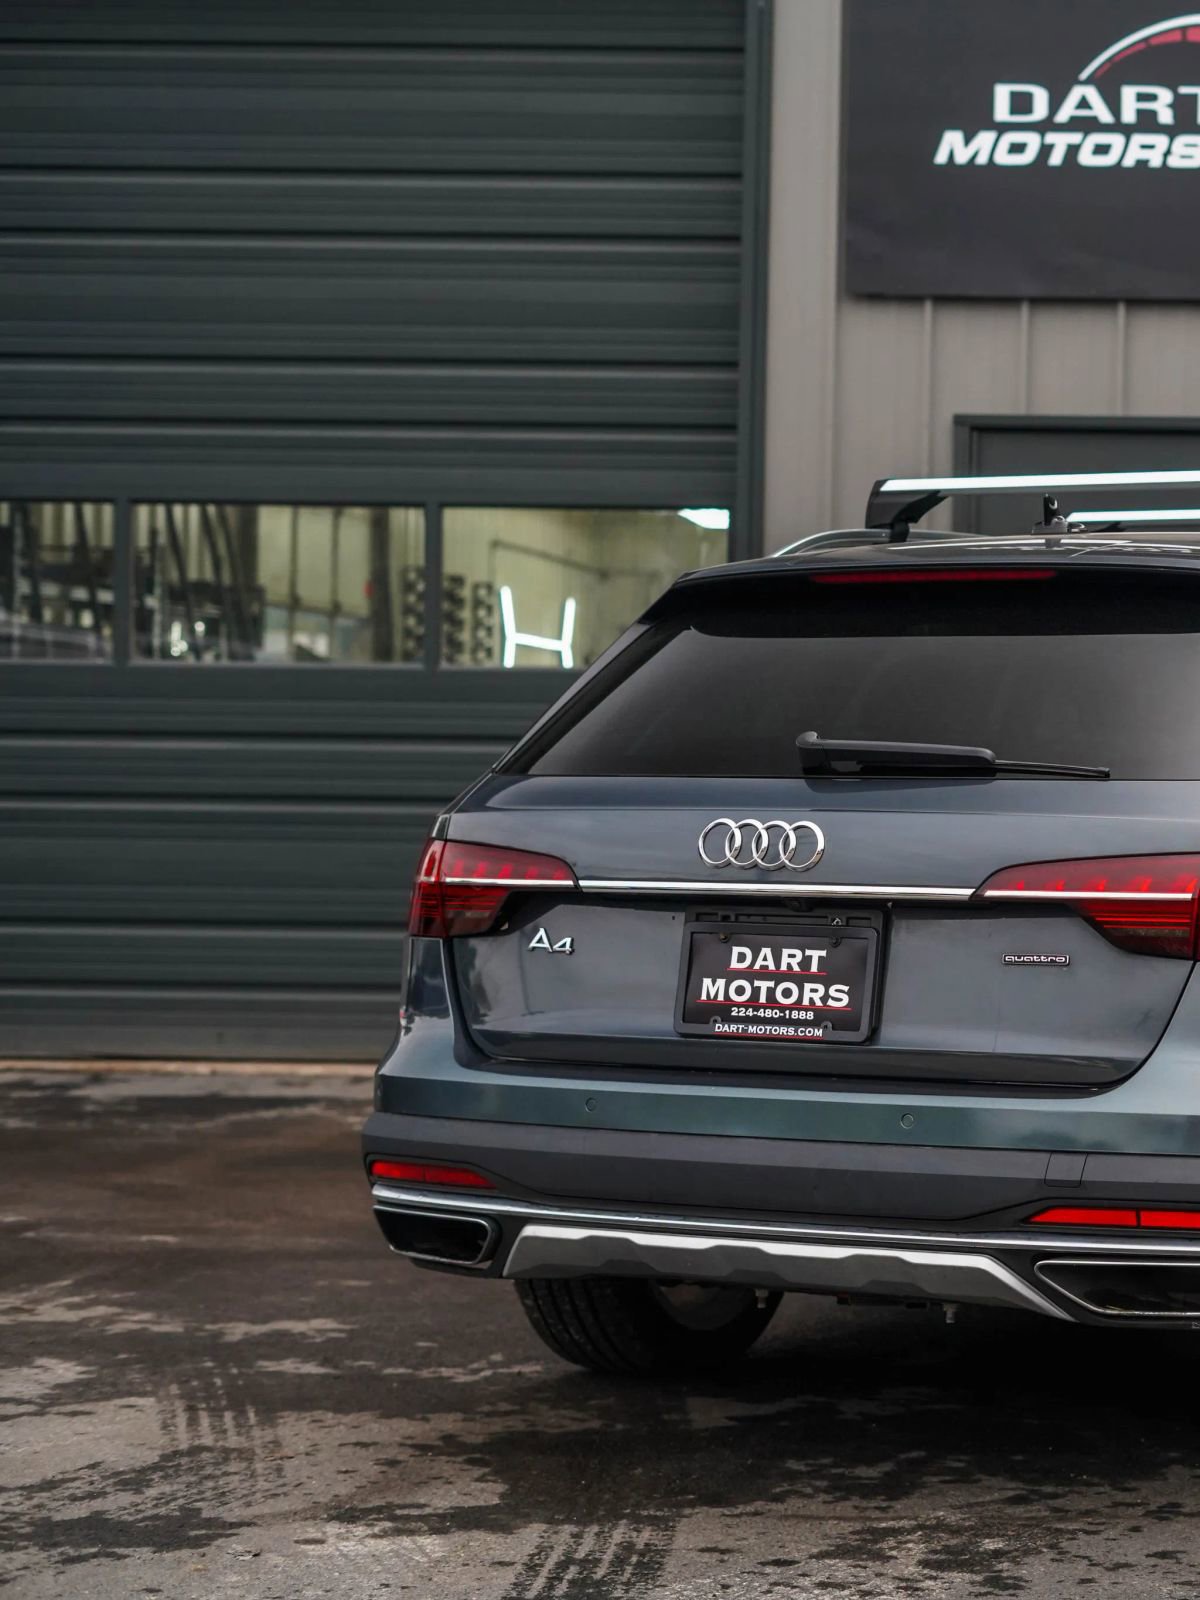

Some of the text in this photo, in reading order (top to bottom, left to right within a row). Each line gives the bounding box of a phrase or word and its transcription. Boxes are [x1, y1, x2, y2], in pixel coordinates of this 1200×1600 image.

[527, 927, 574, 955] A4
[729, 946, 827, 973] DART
[1004, 955, 1066, 963] quattro
[700, 977, 850, 1008] MOTORS
[730, 1007, 814, 1020] 224-480-1888
[714, 1023, 823, 1037] DART-MOTORS.COM
